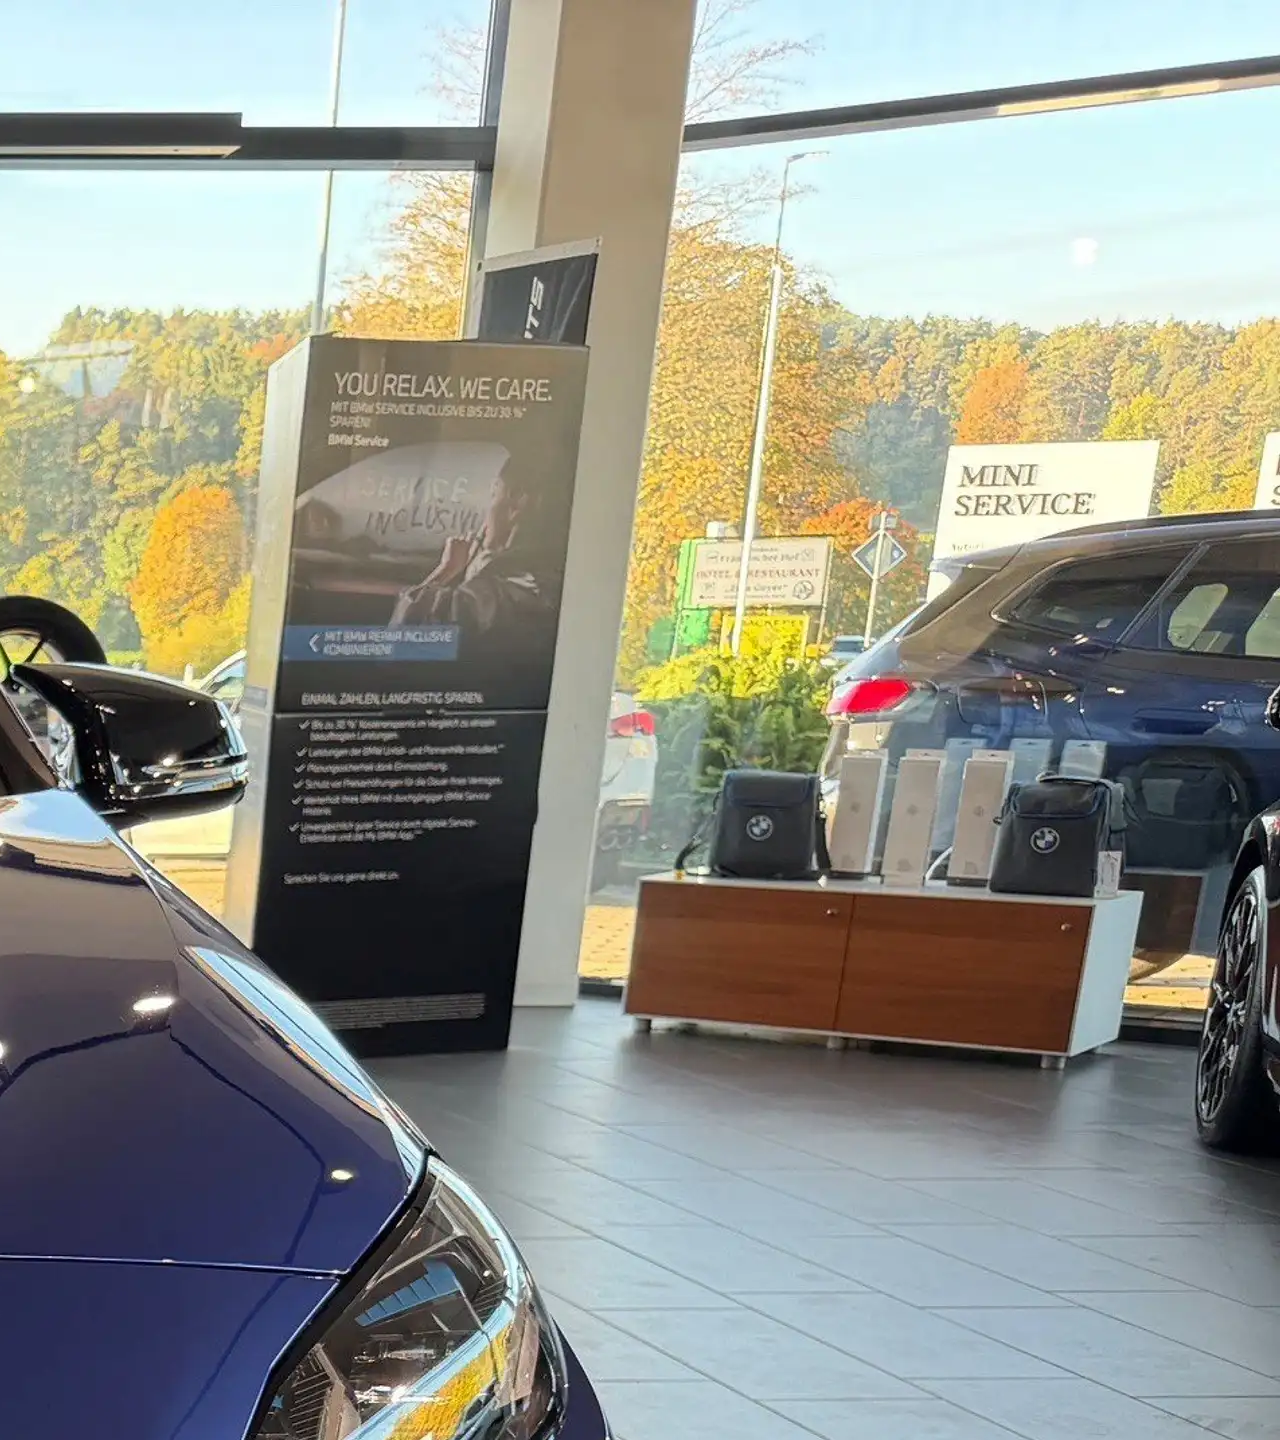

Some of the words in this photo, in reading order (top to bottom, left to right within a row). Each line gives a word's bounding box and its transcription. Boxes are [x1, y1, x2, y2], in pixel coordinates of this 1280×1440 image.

[334, 371, 379, 397] YOU
[382, 373, 454, 398] RELAX.
[459, 376, 492, 400] WE
[495, 377, 553, 402] CARE.
[375, 402, 417, 415] SERVICE
[328, 433, 353, 446] BMW
[354, 434, 389, 447] Service
[957, 463, 1039, 488] MINI
[954, 492, 1093, 517] SERVICE
